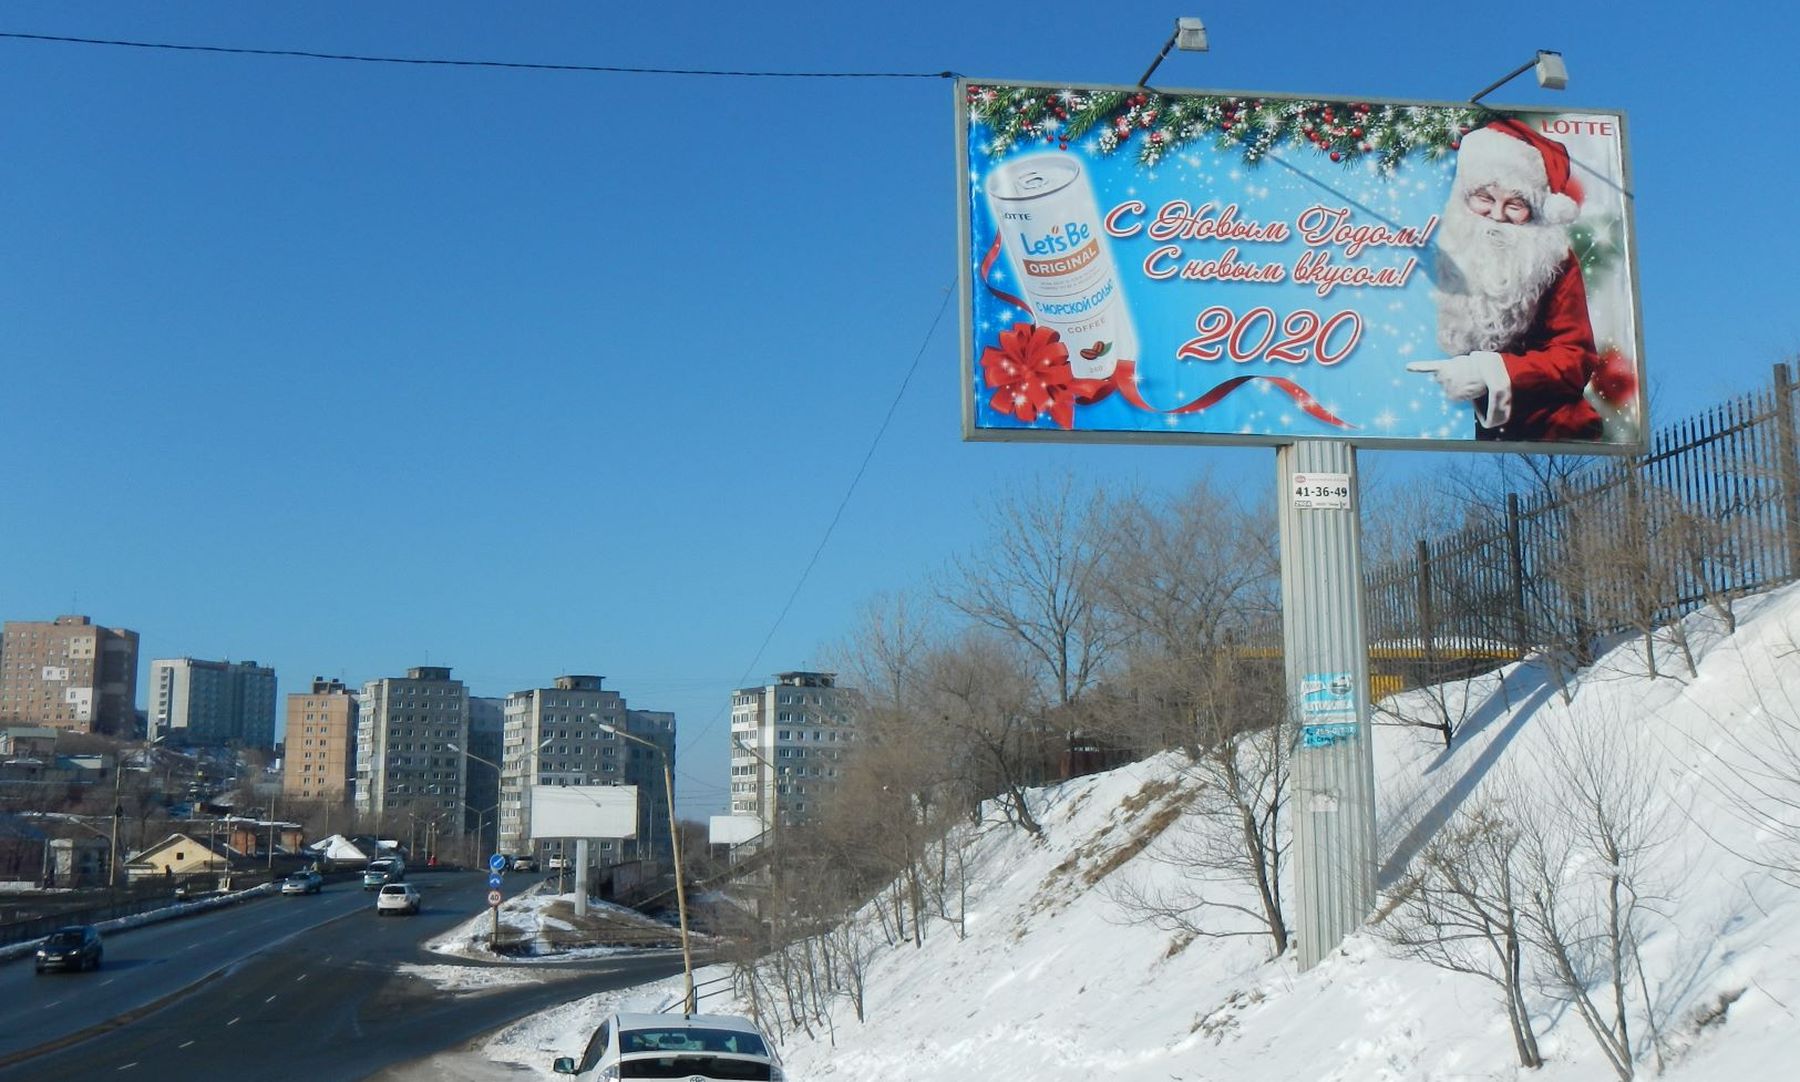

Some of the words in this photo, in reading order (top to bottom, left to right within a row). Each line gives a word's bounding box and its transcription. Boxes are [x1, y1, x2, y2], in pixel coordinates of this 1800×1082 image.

[1541, 120, 1612, 136] LOTTE
[1105, 200, 1144, 238] С
[1148, 200, 1289, 241] Новым
[1297, 205, 1439, 257] Годом!
[1028, 247, 1097, 274] ORIGINAL
[1143, 245, 1181, 280] С
[1183, 247, 1285, 282] новым
[1292, 250, 1418, 296] вкусом!
[1176, 306, 1363, 366] 2020
[1295, 486, 1348, 498] 41-36-49
